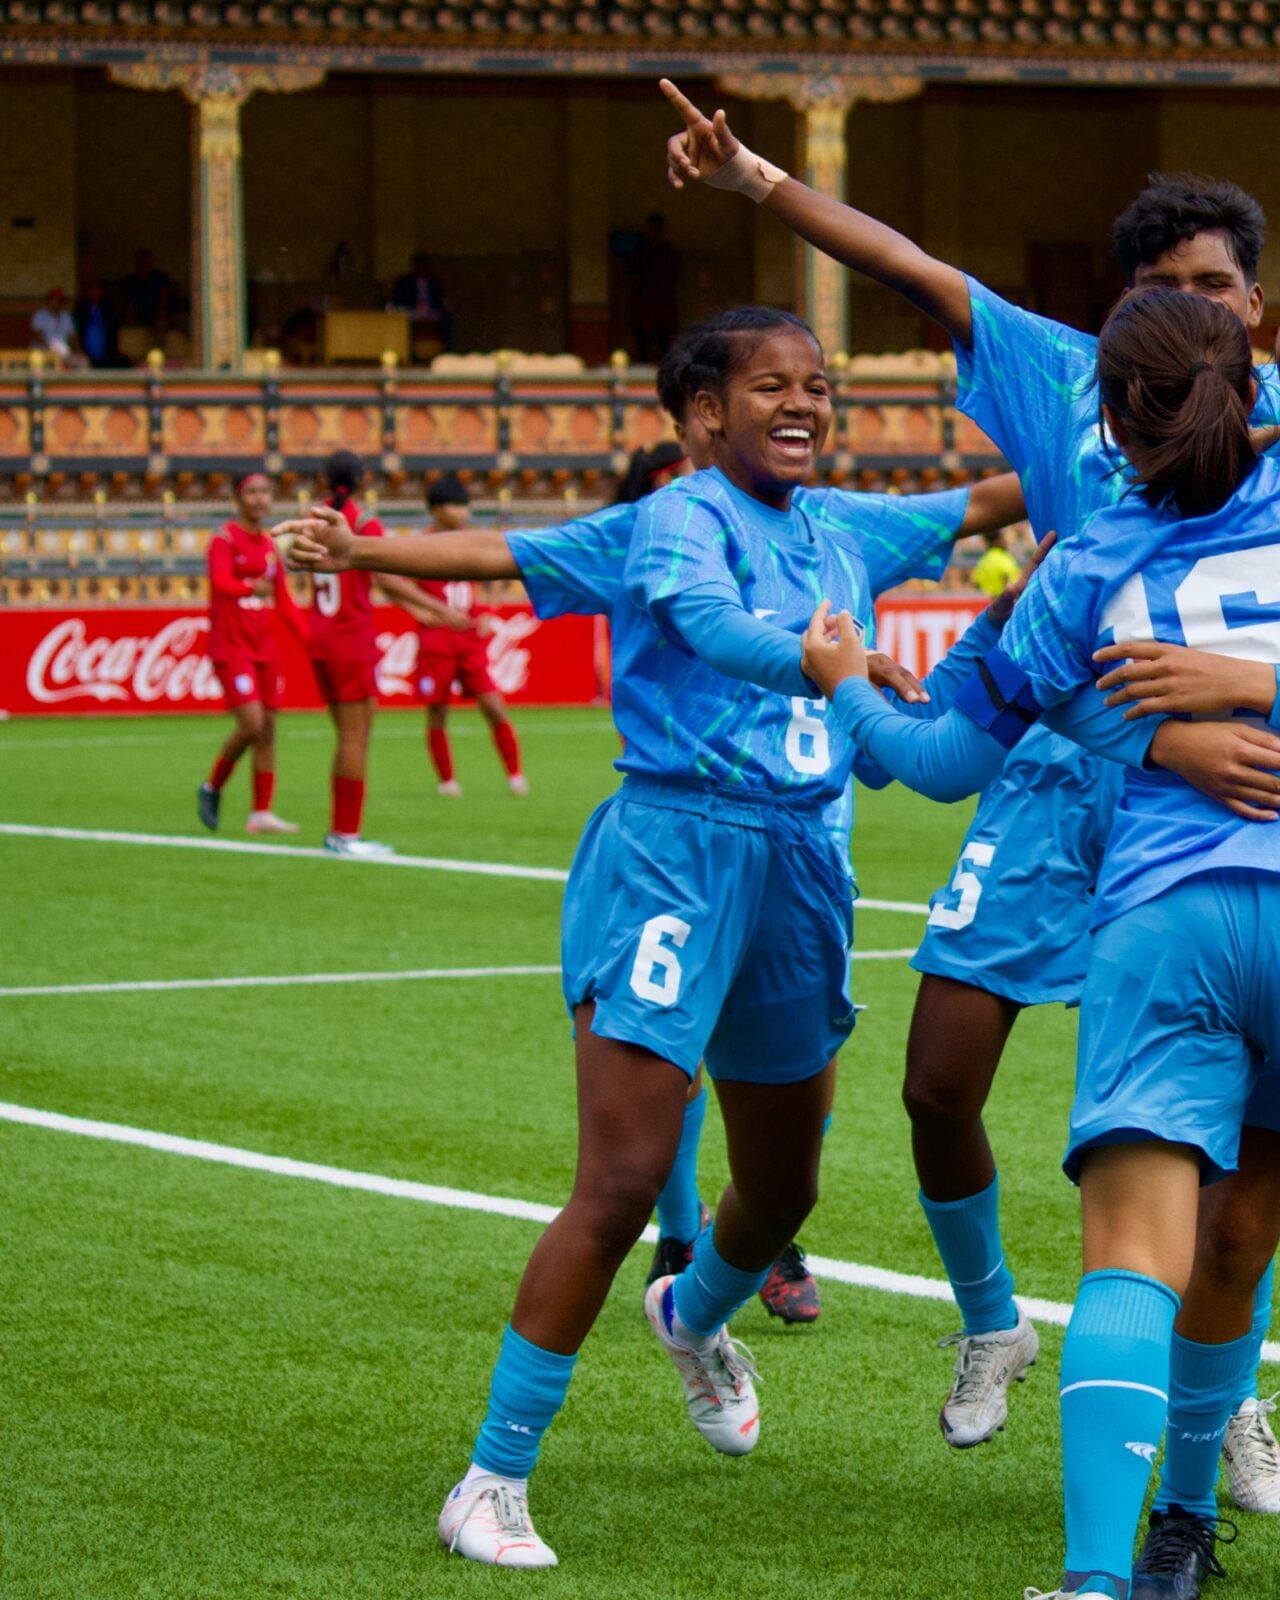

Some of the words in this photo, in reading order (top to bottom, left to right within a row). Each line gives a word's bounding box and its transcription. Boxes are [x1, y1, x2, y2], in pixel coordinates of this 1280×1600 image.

[784, 696, 831, 775] 6
[926, 841, 996, 930] 5
[629, 914, 692, 1007] 6
